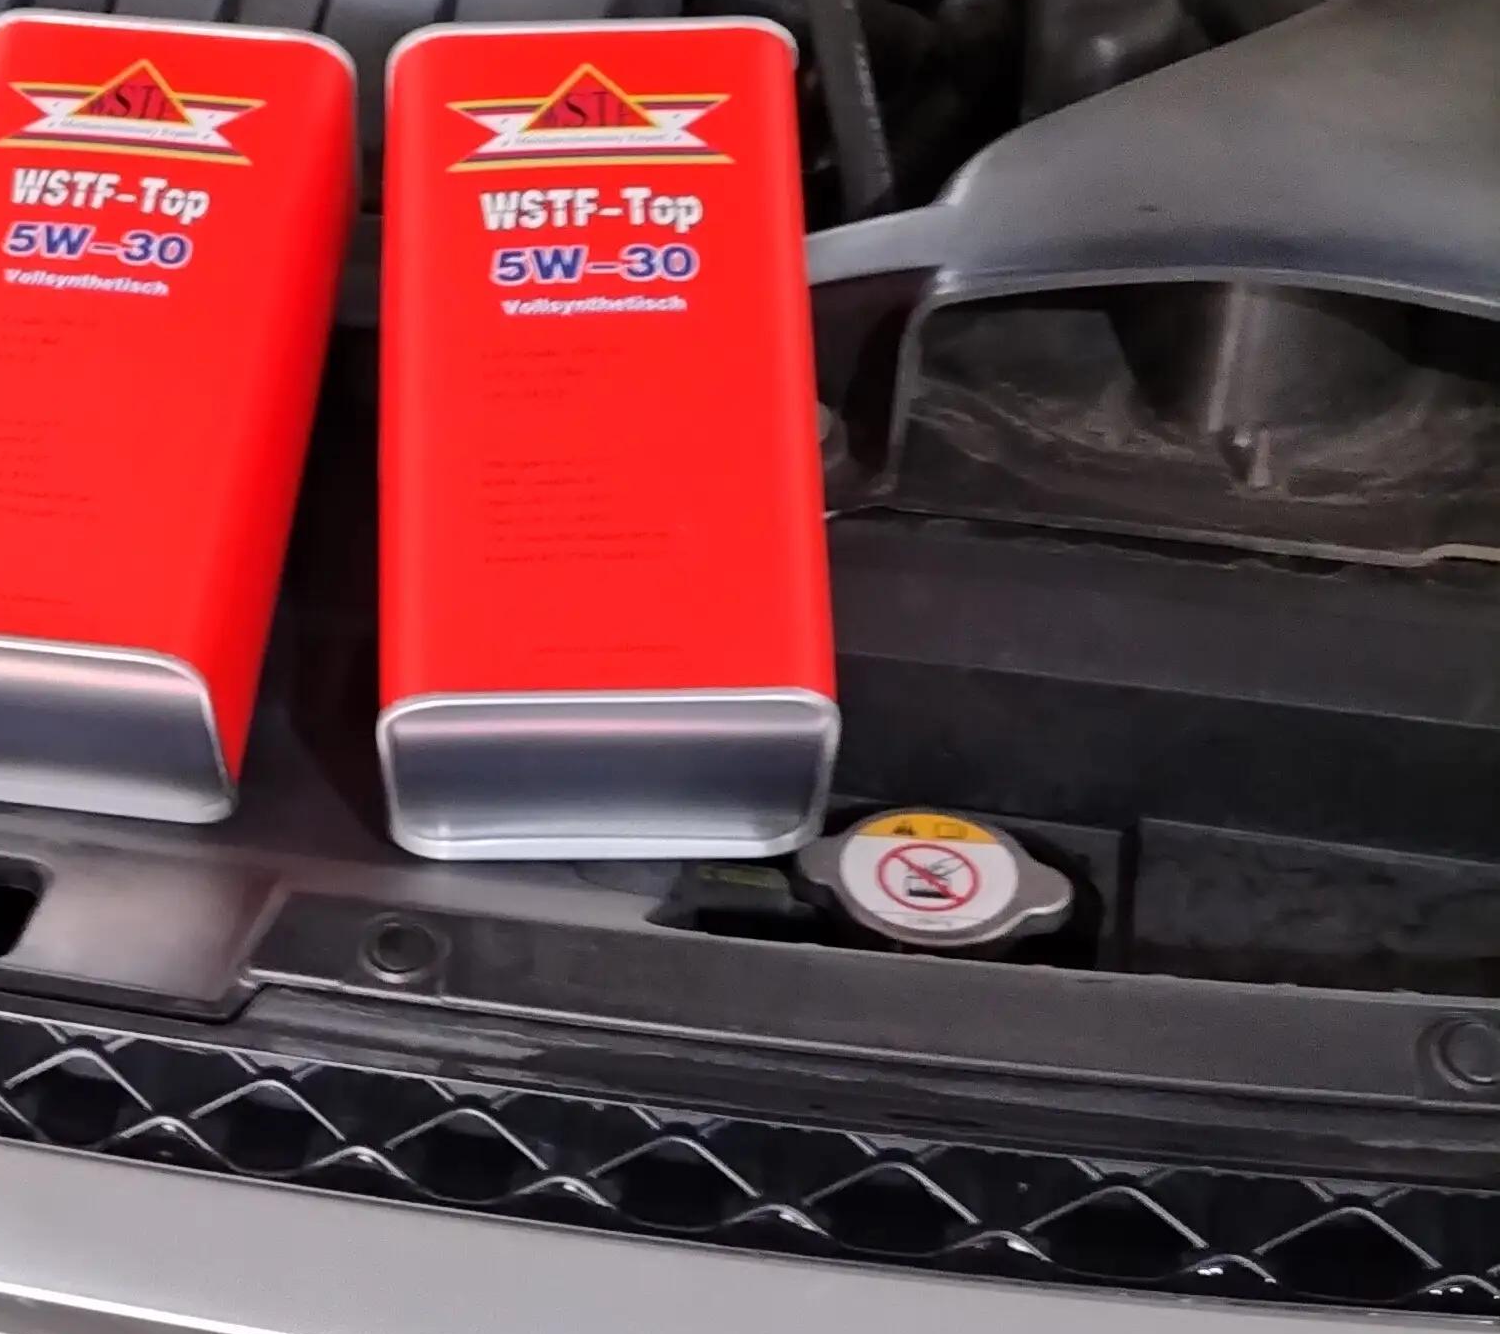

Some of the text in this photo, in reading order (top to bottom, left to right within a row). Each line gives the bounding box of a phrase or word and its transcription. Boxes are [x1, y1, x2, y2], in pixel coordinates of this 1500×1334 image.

[12, 168, 210, 224] WSTF-Top
[480, 187, 704, 233] WSTF-Top
[2, 220, 193, 269] 5W-30
[489, 243, 700, 287] 5W-30
